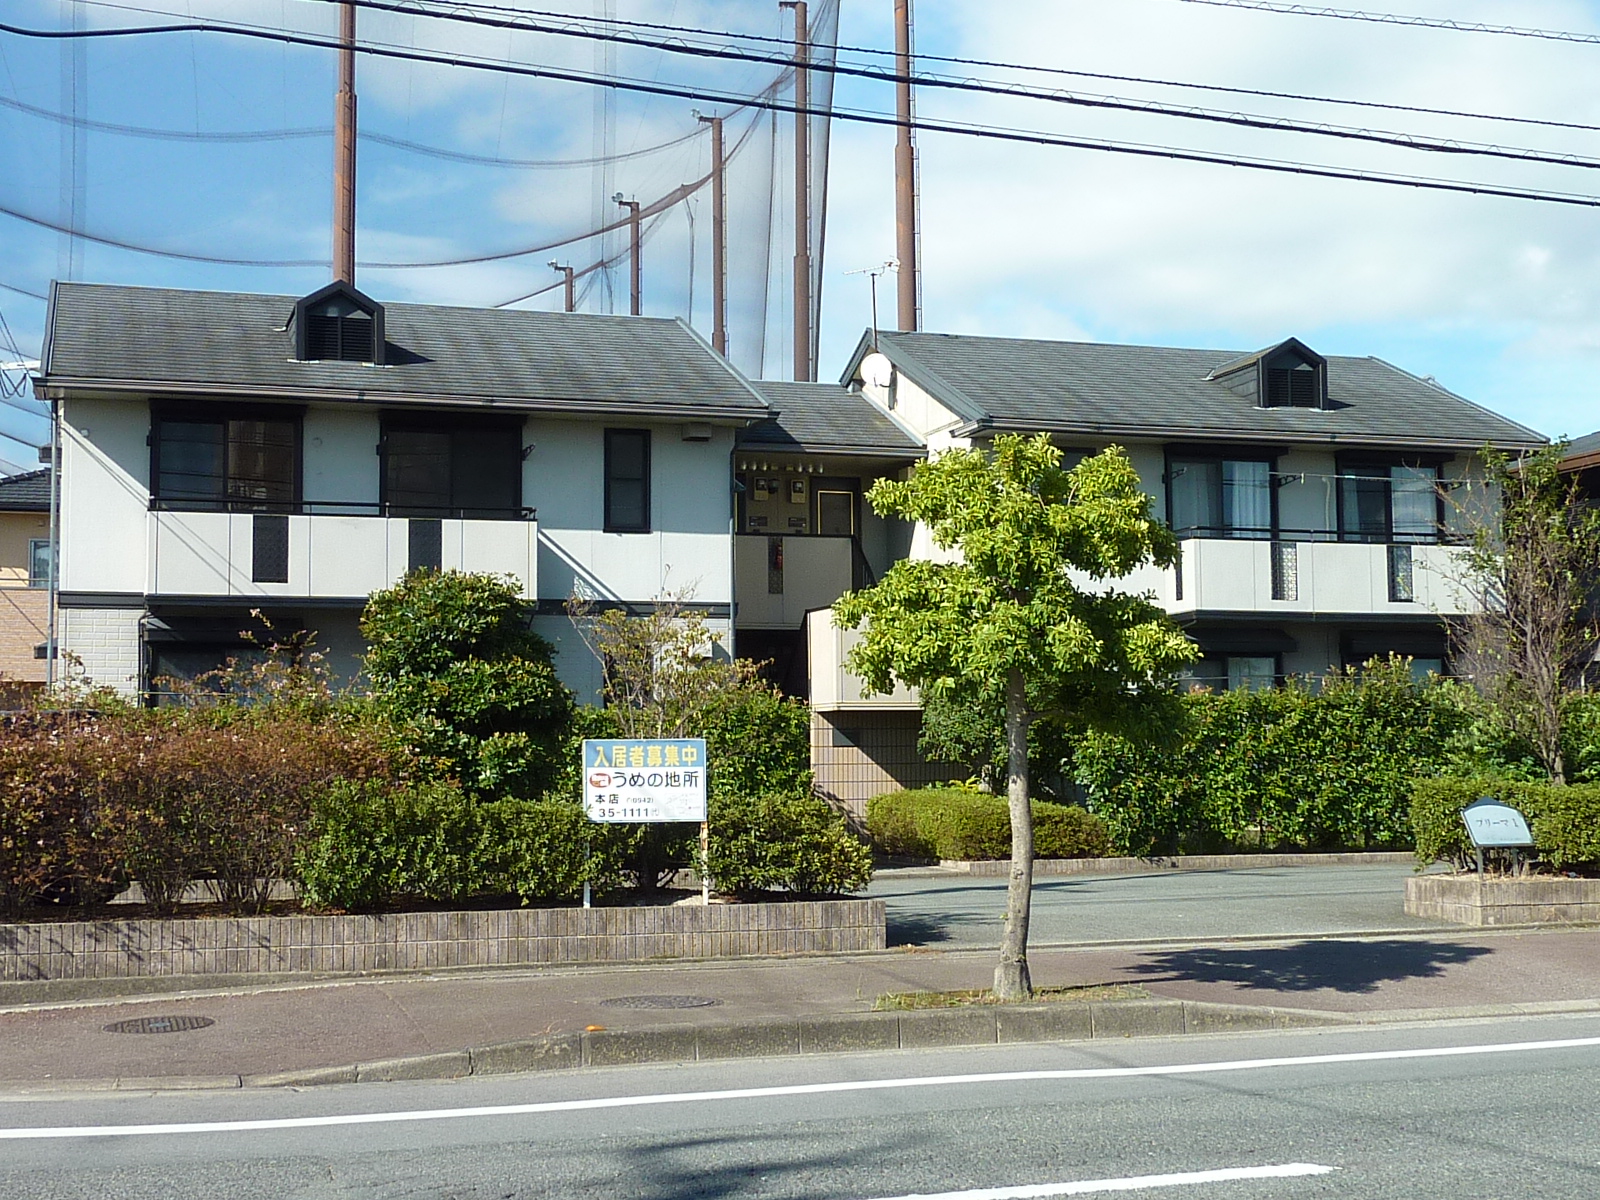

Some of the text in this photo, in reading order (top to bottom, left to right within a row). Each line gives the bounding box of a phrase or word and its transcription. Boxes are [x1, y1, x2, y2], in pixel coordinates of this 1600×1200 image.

[594, 745, 698, 768] 入居者募集中
[612, 771, 699, 788] うめの地所
[595, 793, 619, 804] 本店
